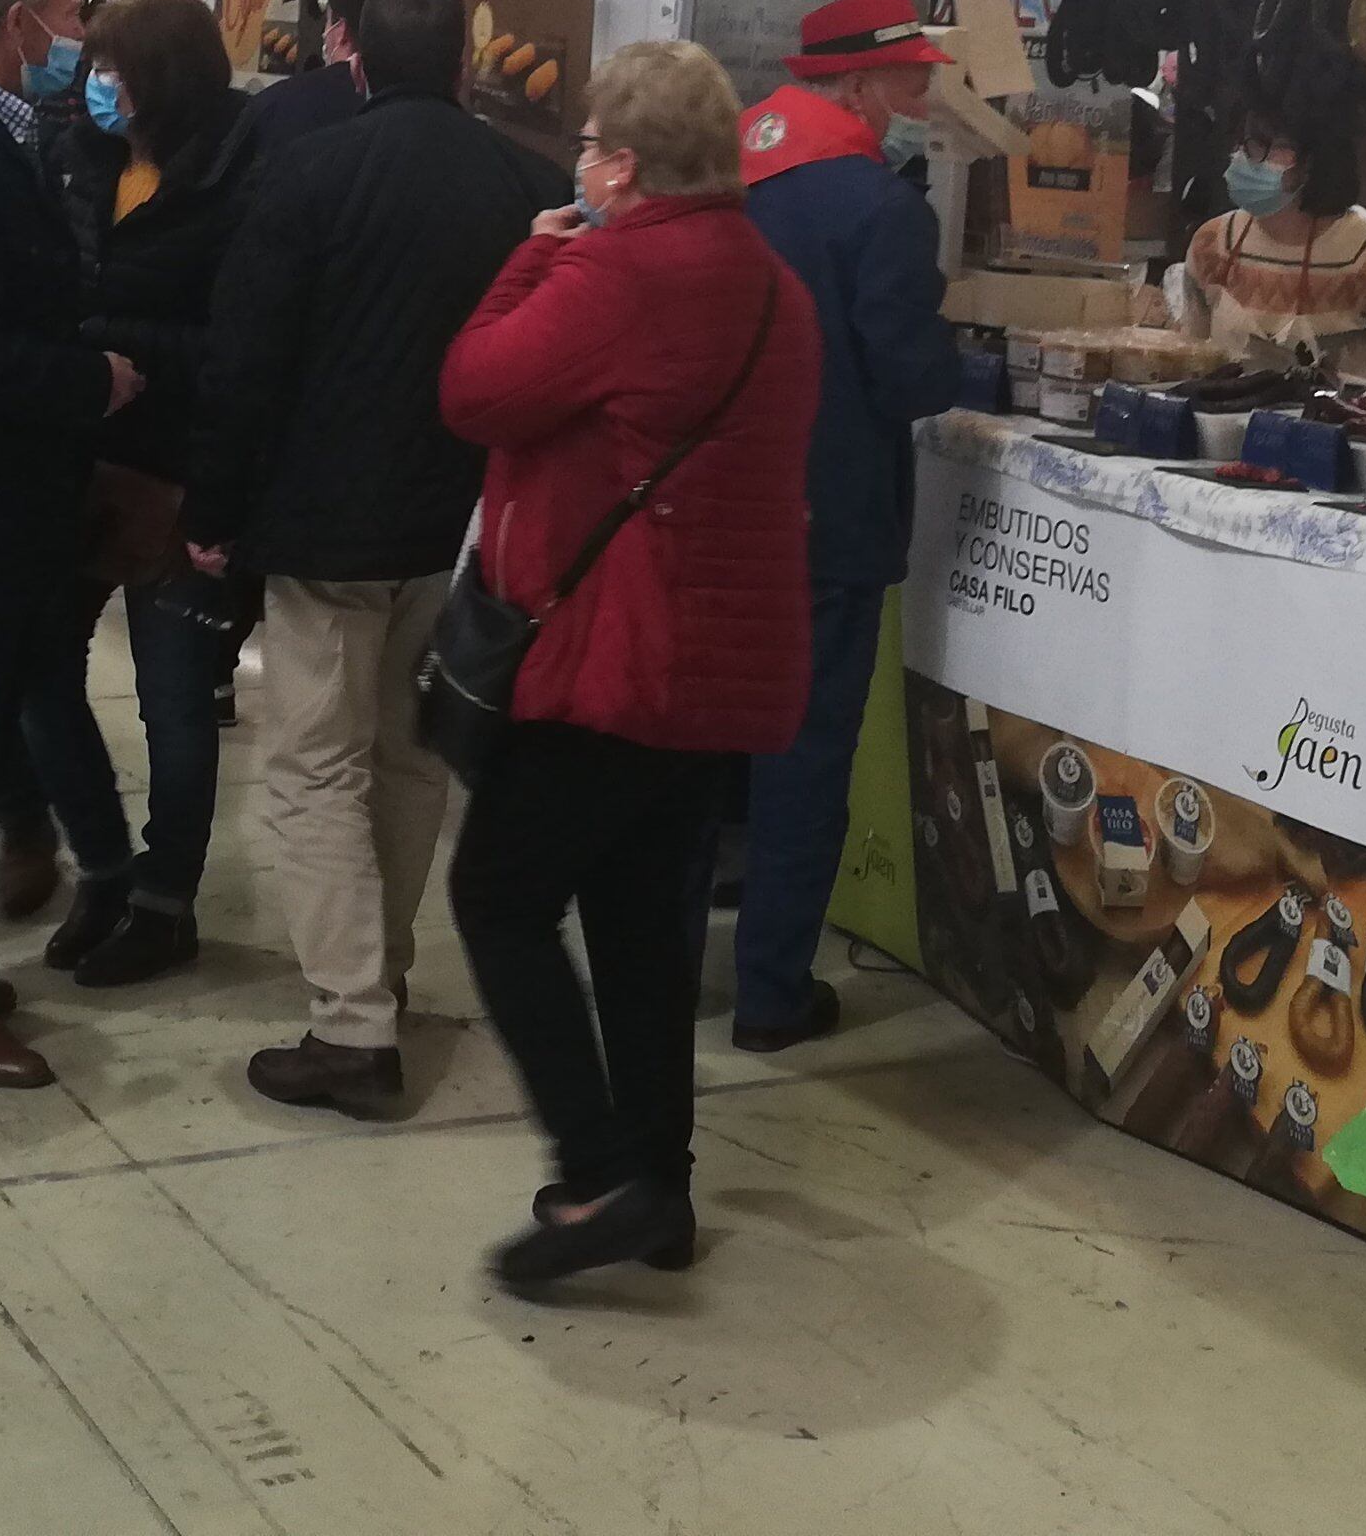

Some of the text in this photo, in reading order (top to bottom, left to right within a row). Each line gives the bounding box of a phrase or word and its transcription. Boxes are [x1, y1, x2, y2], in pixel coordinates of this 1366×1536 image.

[959, 493, 1090, 555] EMBUTIDOS
[956, 530, 1110, 603] Y CONSERVAS
[948, 569, 1035, 616] CASA FILO
[1290, 697, 1356, 740] Degusta
[1103, 807, 1134, 820] CASA
